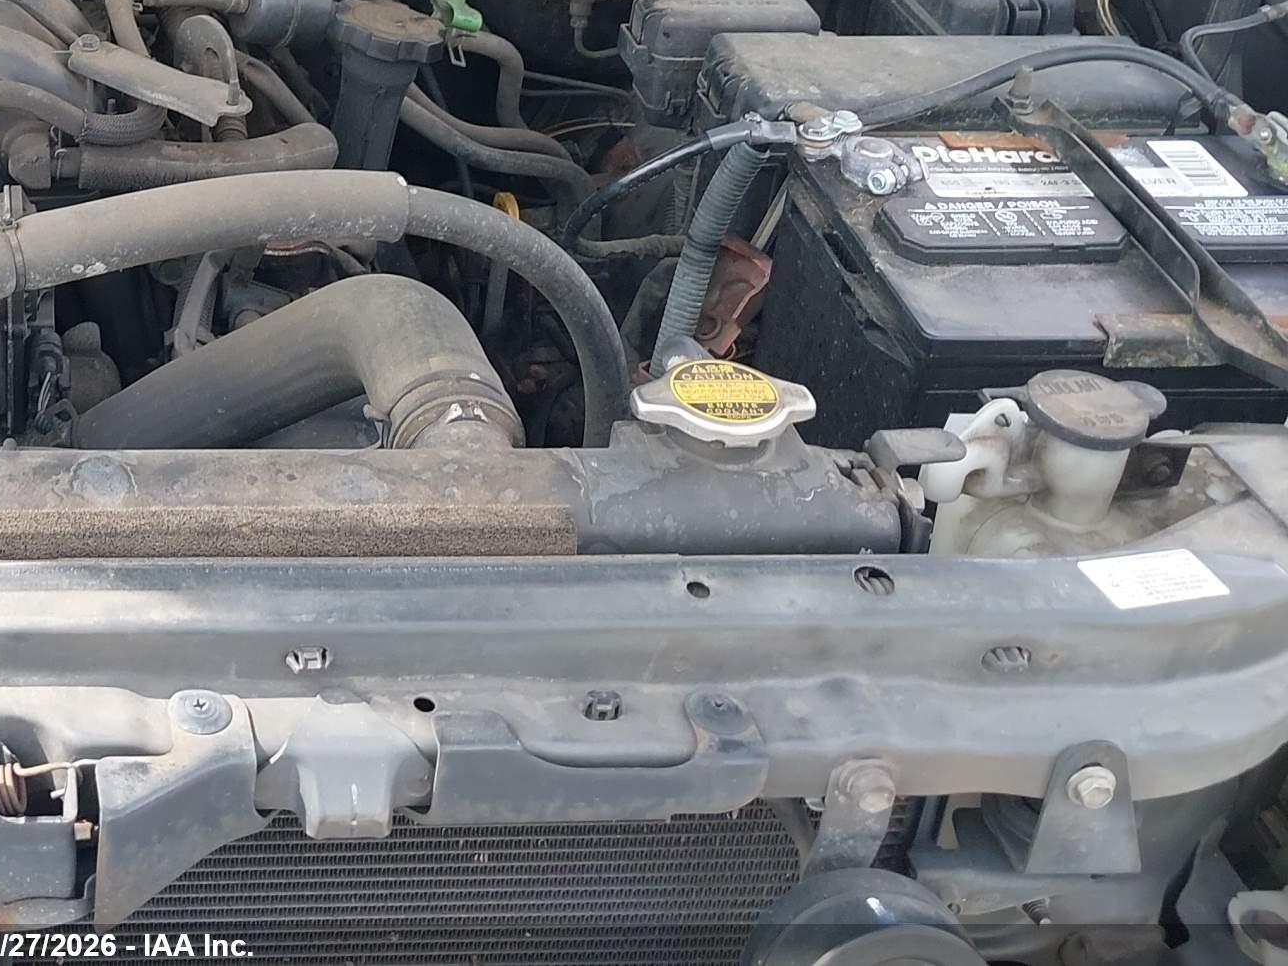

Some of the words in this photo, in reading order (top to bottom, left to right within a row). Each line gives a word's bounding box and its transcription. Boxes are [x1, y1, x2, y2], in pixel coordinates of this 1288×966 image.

[938, 202, 995, 211] DANGER
[1007, 200, 1060, 209] POISON
[681, 372, 754, 381] CAUTION
